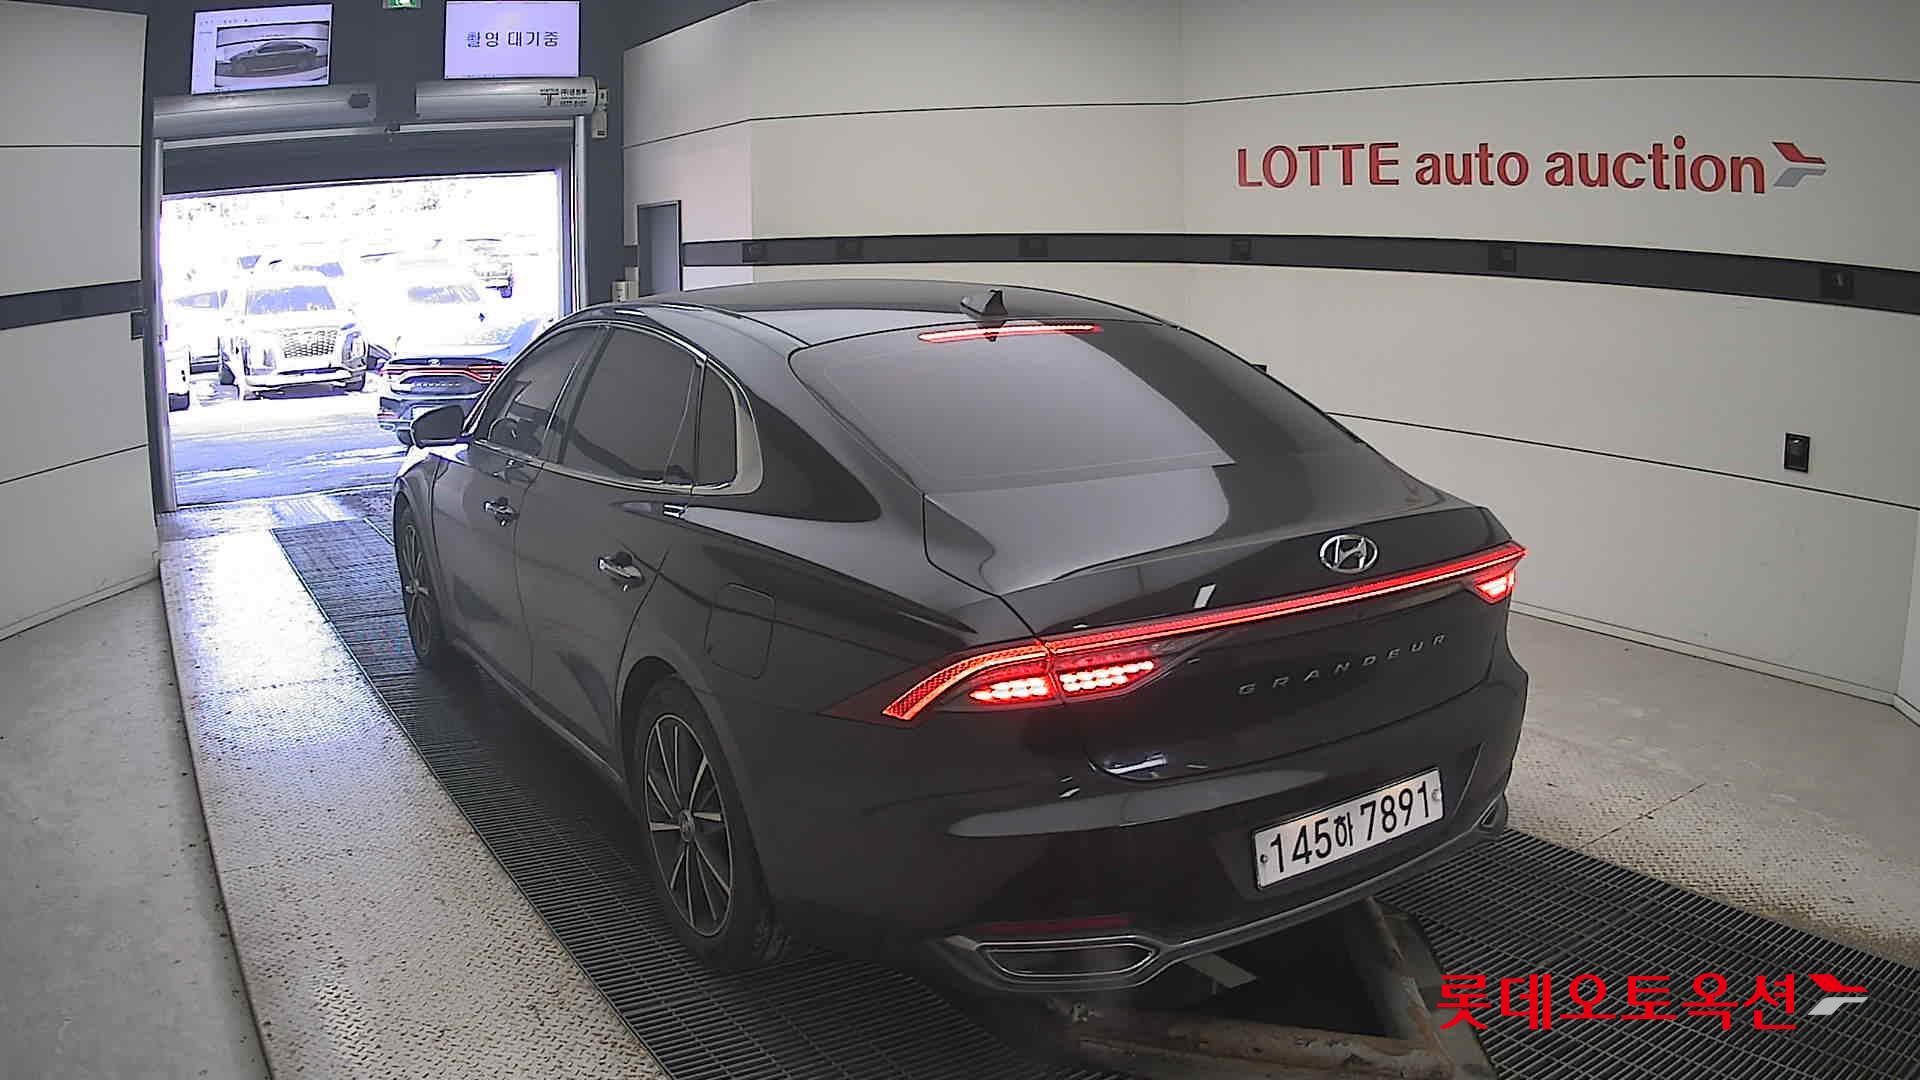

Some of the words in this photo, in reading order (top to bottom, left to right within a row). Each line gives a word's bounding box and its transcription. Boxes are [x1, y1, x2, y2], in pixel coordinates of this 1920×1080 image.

[508, 31, 560, 48] 대기중
[1237, 142, 1400, 188] LOTTE
[1415, 142, 1529, 187] auto
[1544, 135, 1766, 194] auction
[1239, 634, 1445, 695] GRANDEUR
[1359, 780, 1429, 841] 7891
